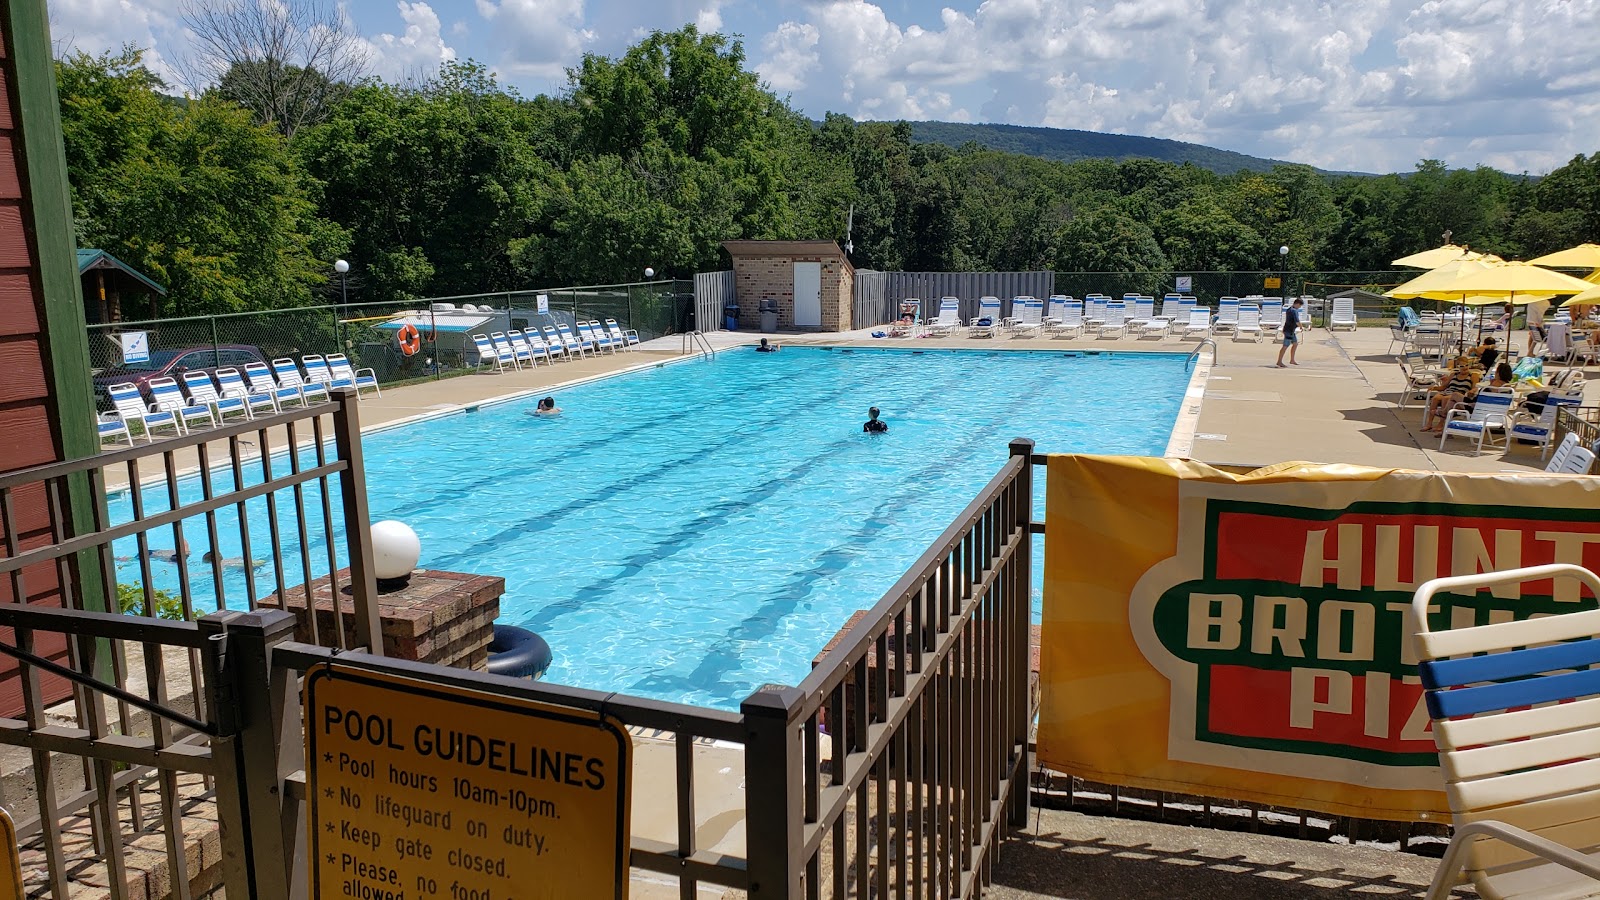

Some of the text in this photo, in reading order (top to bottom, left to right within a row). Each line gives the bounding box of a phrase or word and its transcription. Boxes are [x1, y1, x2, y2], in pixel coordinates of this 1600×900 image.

[325, 705, 404, 751] POOL
[414, 724, 605, 790] GUIDELINES
[340, 752, 561, 819] Pool hours 10am-10pm.
[340, 786, 549, 856] No lifeguard on duty.
[341, 820, 511, 879] Keep gate closed.
[417, 876, 437, 894] no
[450, 880, 491, 900] food
